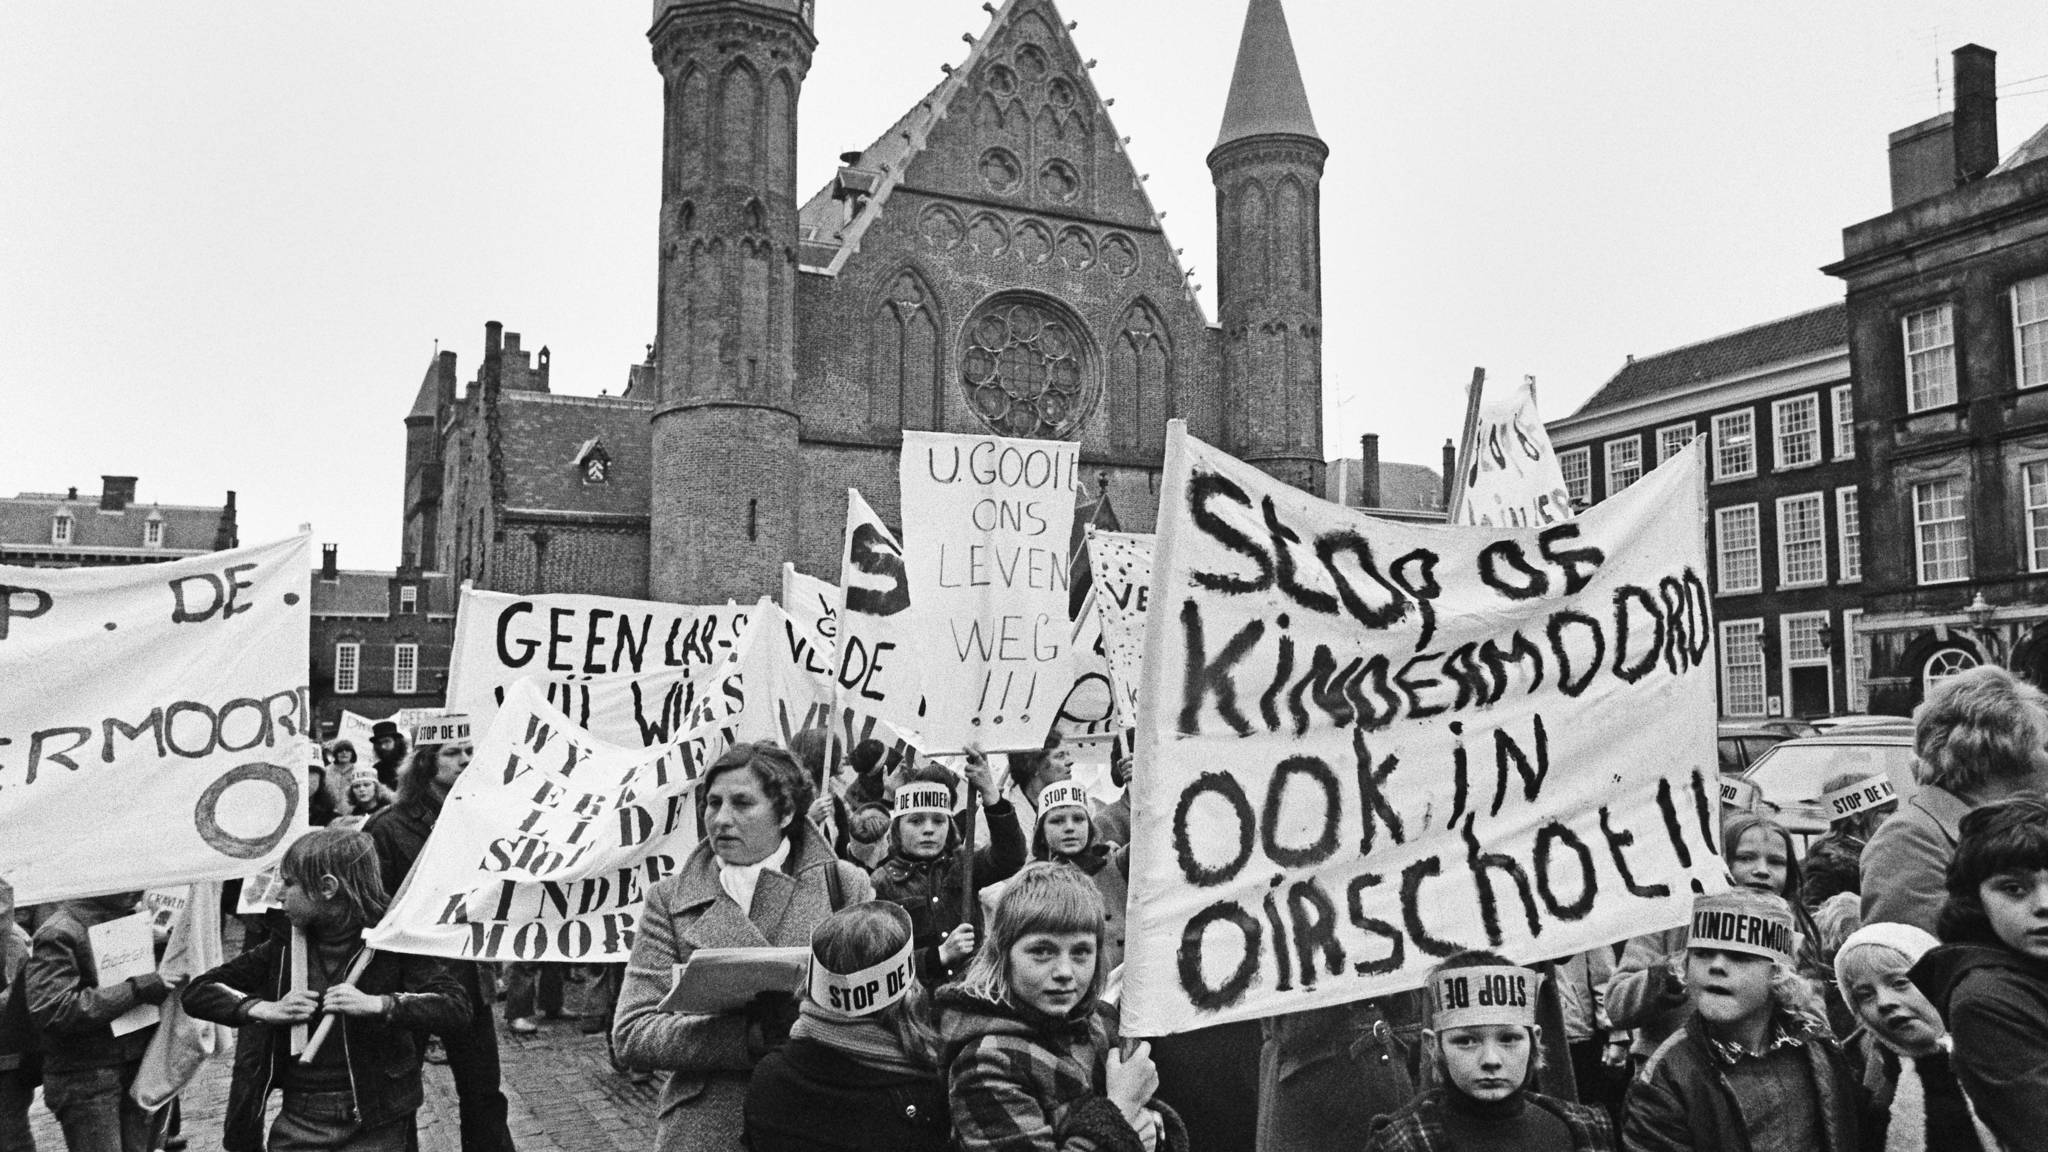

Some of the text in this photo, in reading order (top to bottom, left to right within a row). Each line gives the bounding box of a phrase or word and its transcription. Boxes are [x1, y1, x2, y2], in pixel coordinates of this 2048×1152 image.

[972, 498, 1047, 536] ONS
[939, 543, 1069, 591] LEVEN
[497, 601, 653, 673] GEEN
[949, 612, 1059, 662] WEG
[419, 725, 438, 741] STOP
[441, 724, 454, 740] DE
[900, 792, 910, 811] DE
[1044, 787, 1083, 807] STOP DE
[1171, 726, 1404, 889] OOK
[1832, 792, 1862, 815] STOP
[1863, 785, 1883, 804] DE
[828, 963, 906, 1012] STOP DE
